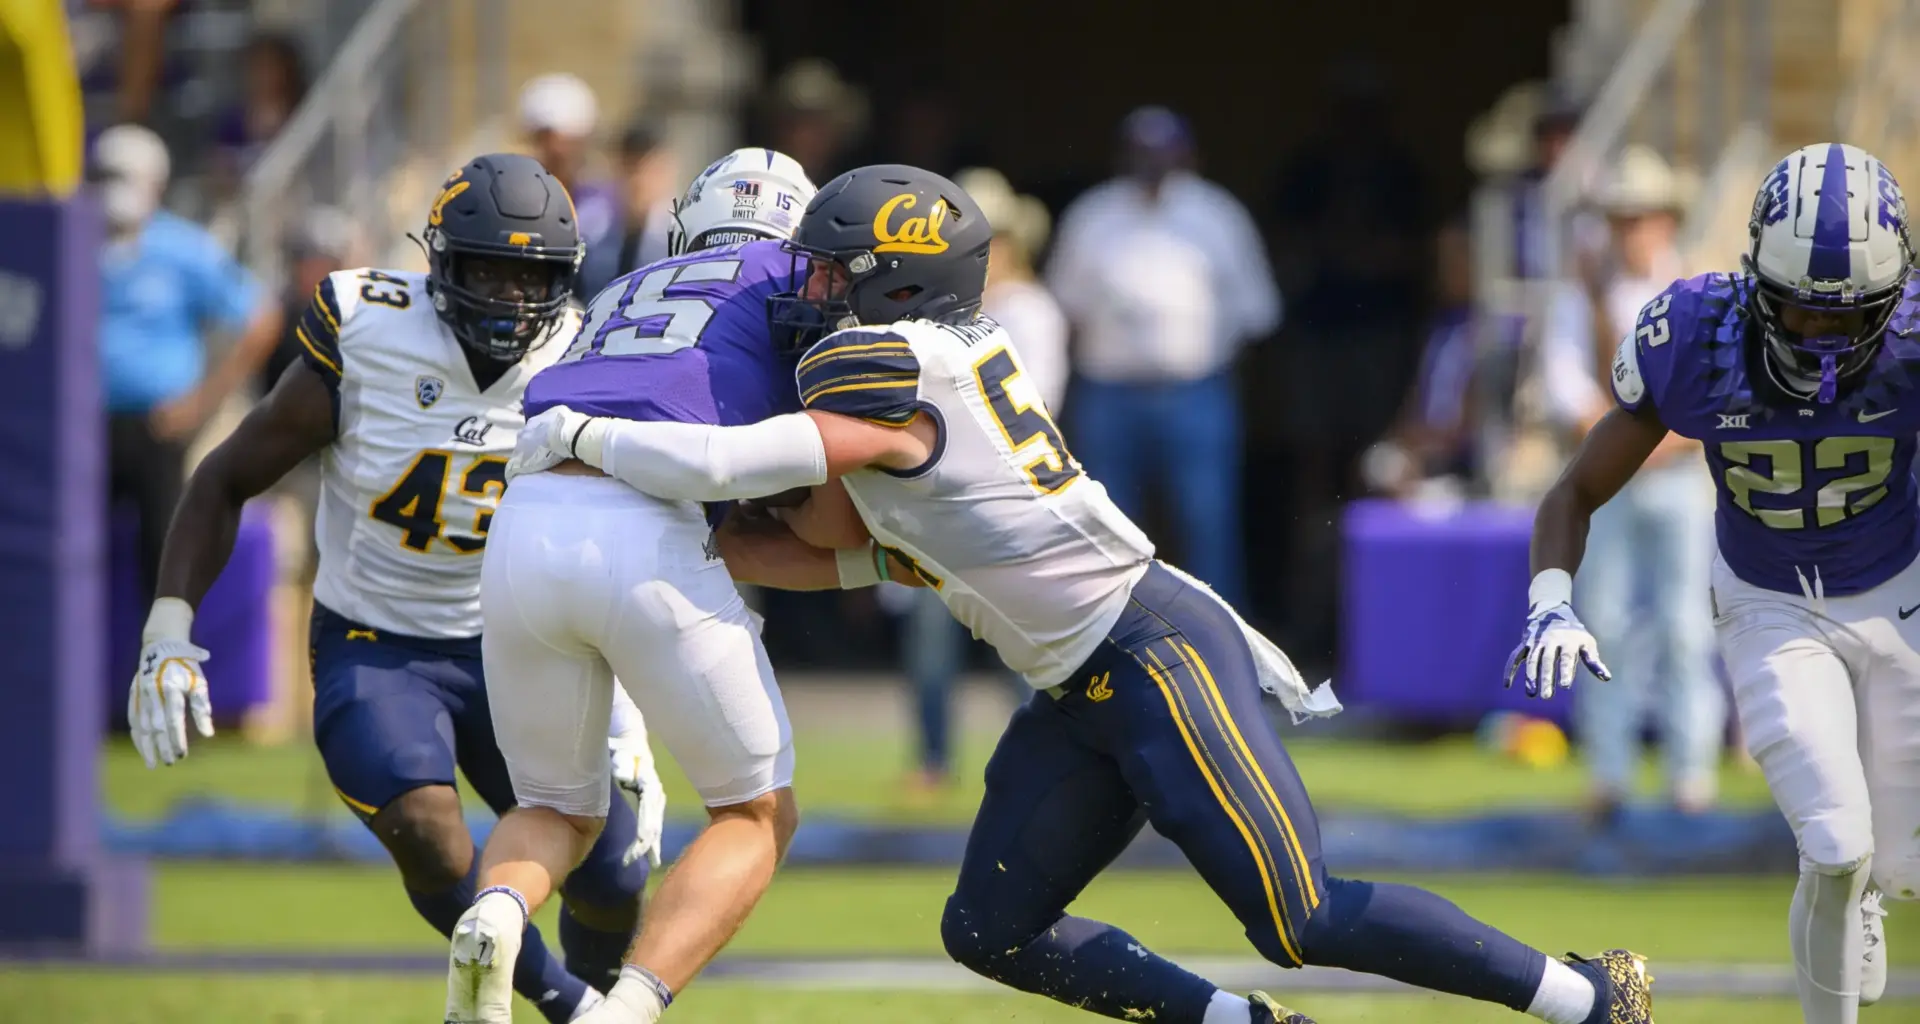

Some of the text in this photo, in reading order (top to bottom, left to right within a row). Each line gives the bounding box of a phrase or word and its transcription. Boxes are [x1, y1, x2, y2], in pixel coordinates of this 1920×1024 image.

[732, 210, 756, 218] UNITY
[776, 192, 791, 211] 15
[873, 194, 949, 254] Cal
[359, 270, 411, 310] 43
[560, 259, 744, 363] 15
[1636, 294, 1673, 348] 22
[453, 416, 493, 446] Cal
[1712, 414, 1750, 429] XII
[368, 448, 508, 554] 43
[1720, 436, 1896, 529] 22
[1086, 671, 1114, 703] Cal
